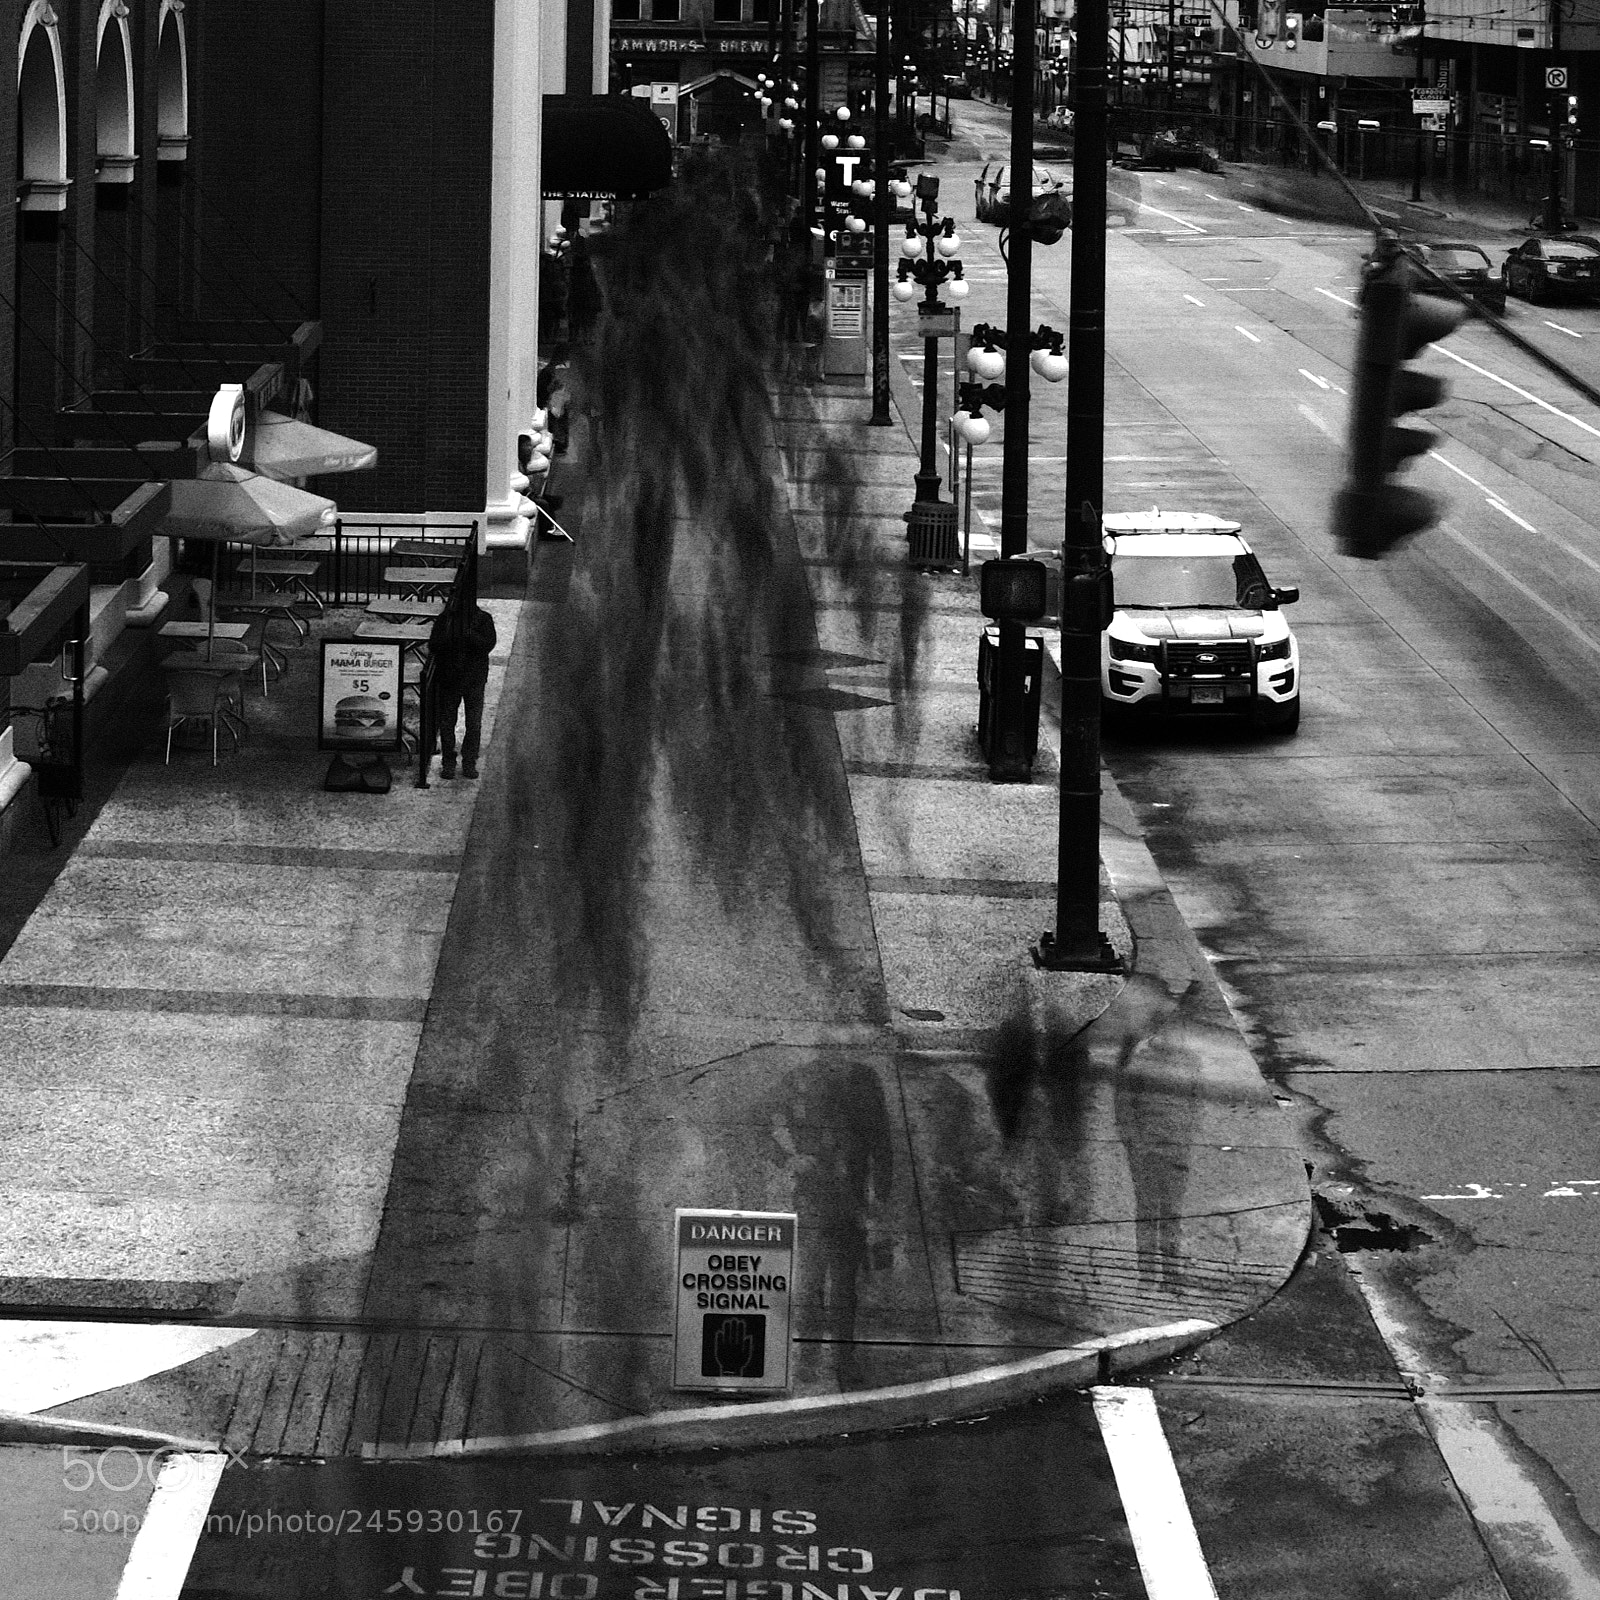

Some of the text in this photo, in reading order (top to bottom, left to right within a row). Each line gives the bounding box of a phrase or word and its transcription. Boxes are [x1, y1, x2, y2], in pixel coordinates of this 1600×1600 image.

[835, 156, 861, 187] T
[566, 191, 617, 200] STATION
[330, 658, 393, 669] MAMA BURGER
[352, 679, 370, 692] $5
[691, 1224, 782, 1241] DANGER
[707, 1254, 761, 1272] OBEY
[682, 1272, 787, 1292] CROSSING
[696, 1292, 770, 1310] SIGNAL
[539, 1499, 818, 1535] SIGNAL
[473, 1532, 875, 1574] CROSSING
